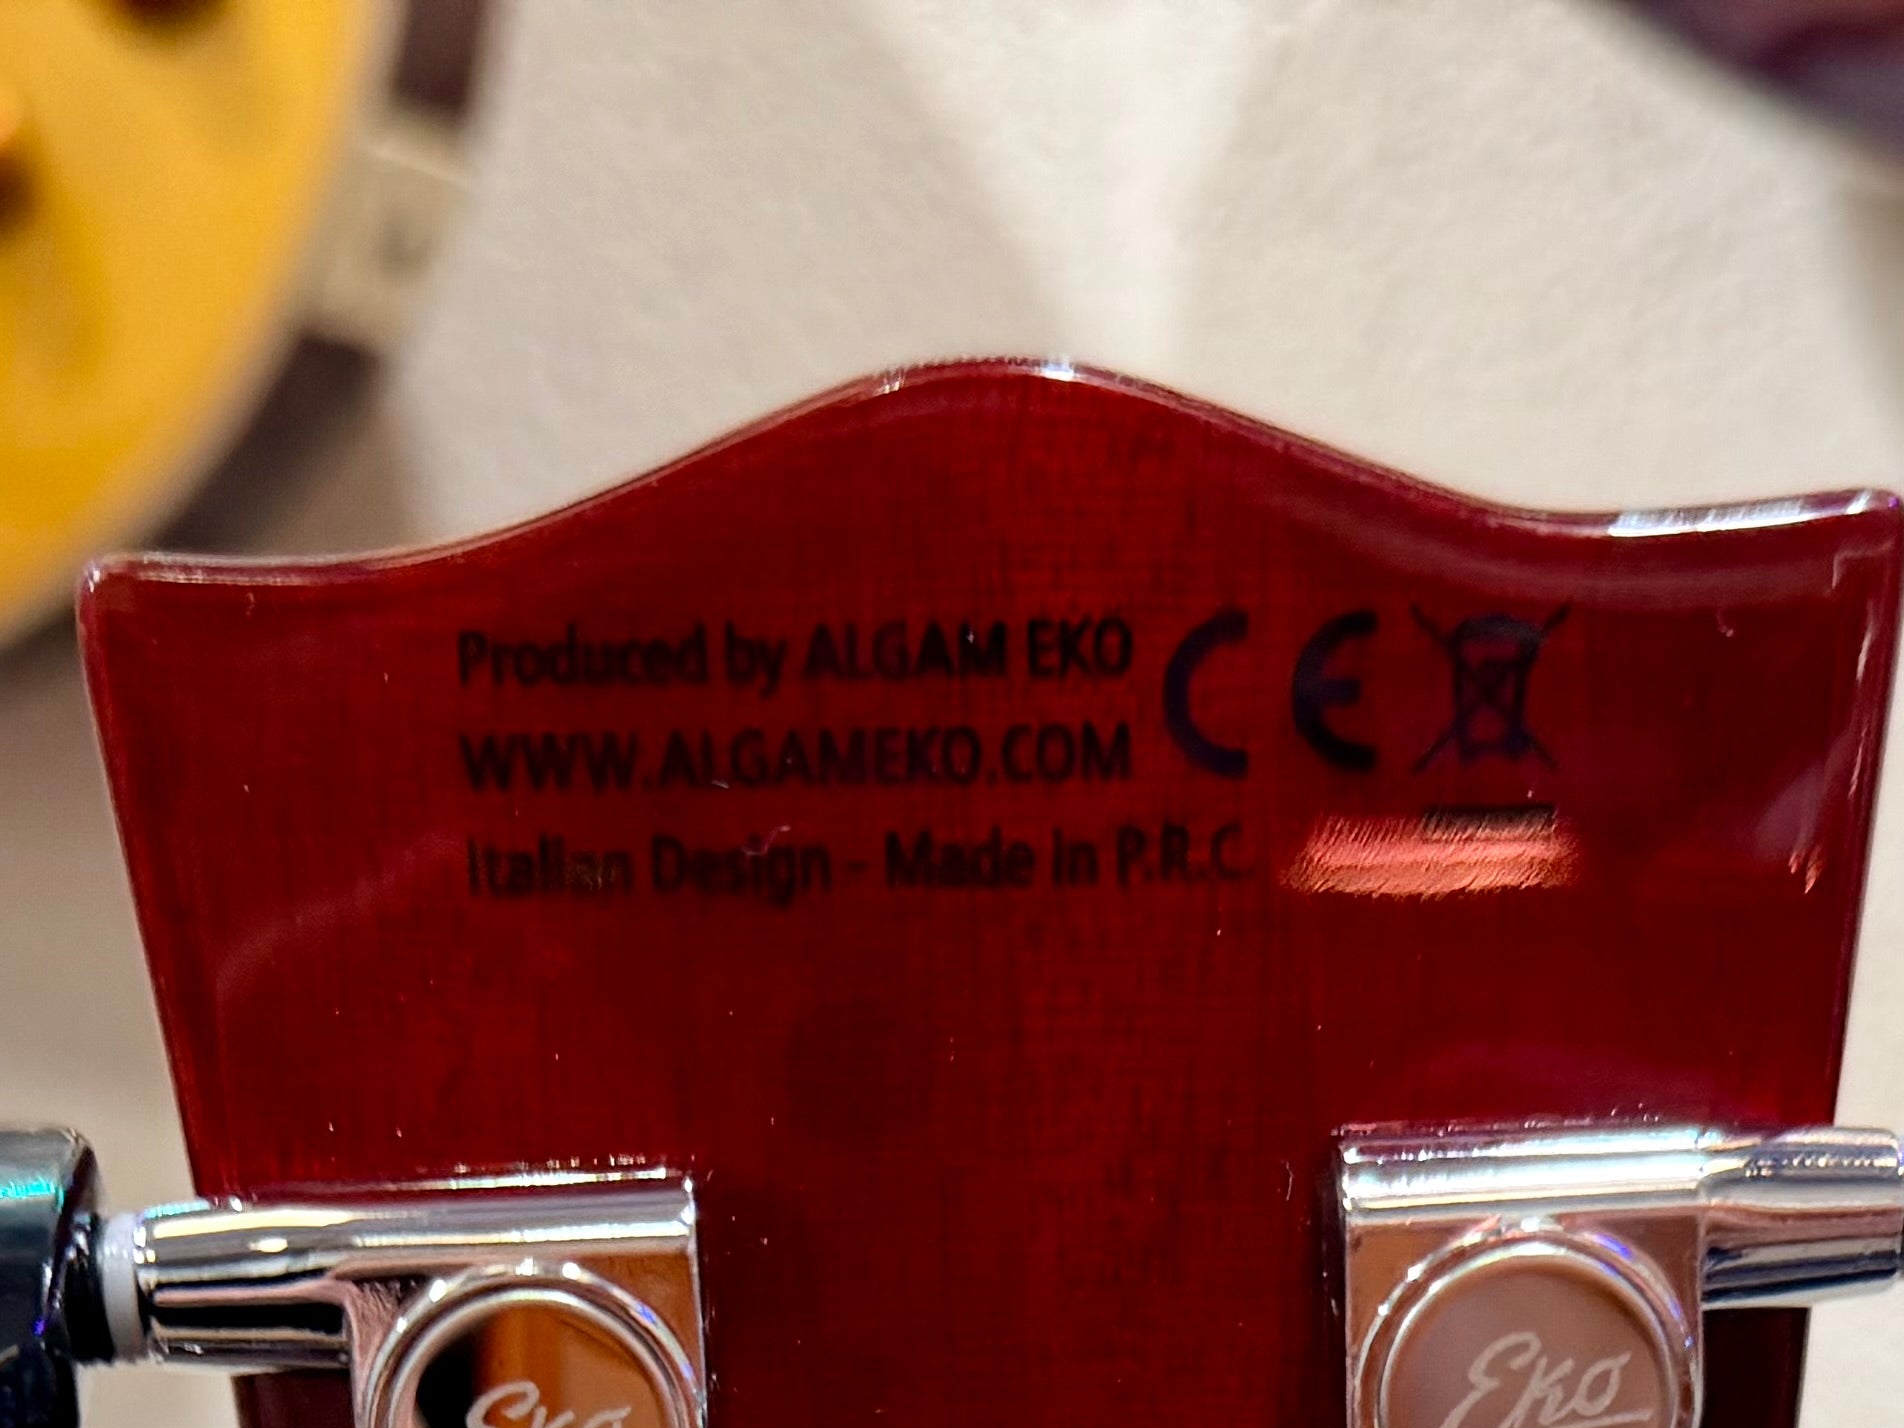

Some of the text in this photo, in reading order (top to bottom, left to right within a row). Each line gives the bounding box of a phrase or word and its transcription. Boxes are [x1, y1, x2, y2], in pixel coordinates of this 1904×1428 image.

[458, 614, 1134, 700] Produced by ALGAM EKO
[459, 720, 1133, 793] WWW.ALGAMEKO.COM
[467, 833, 634, 897] Italian
[651, 831, 832, 906] Design
[885, 825, 1035, 888] Made
